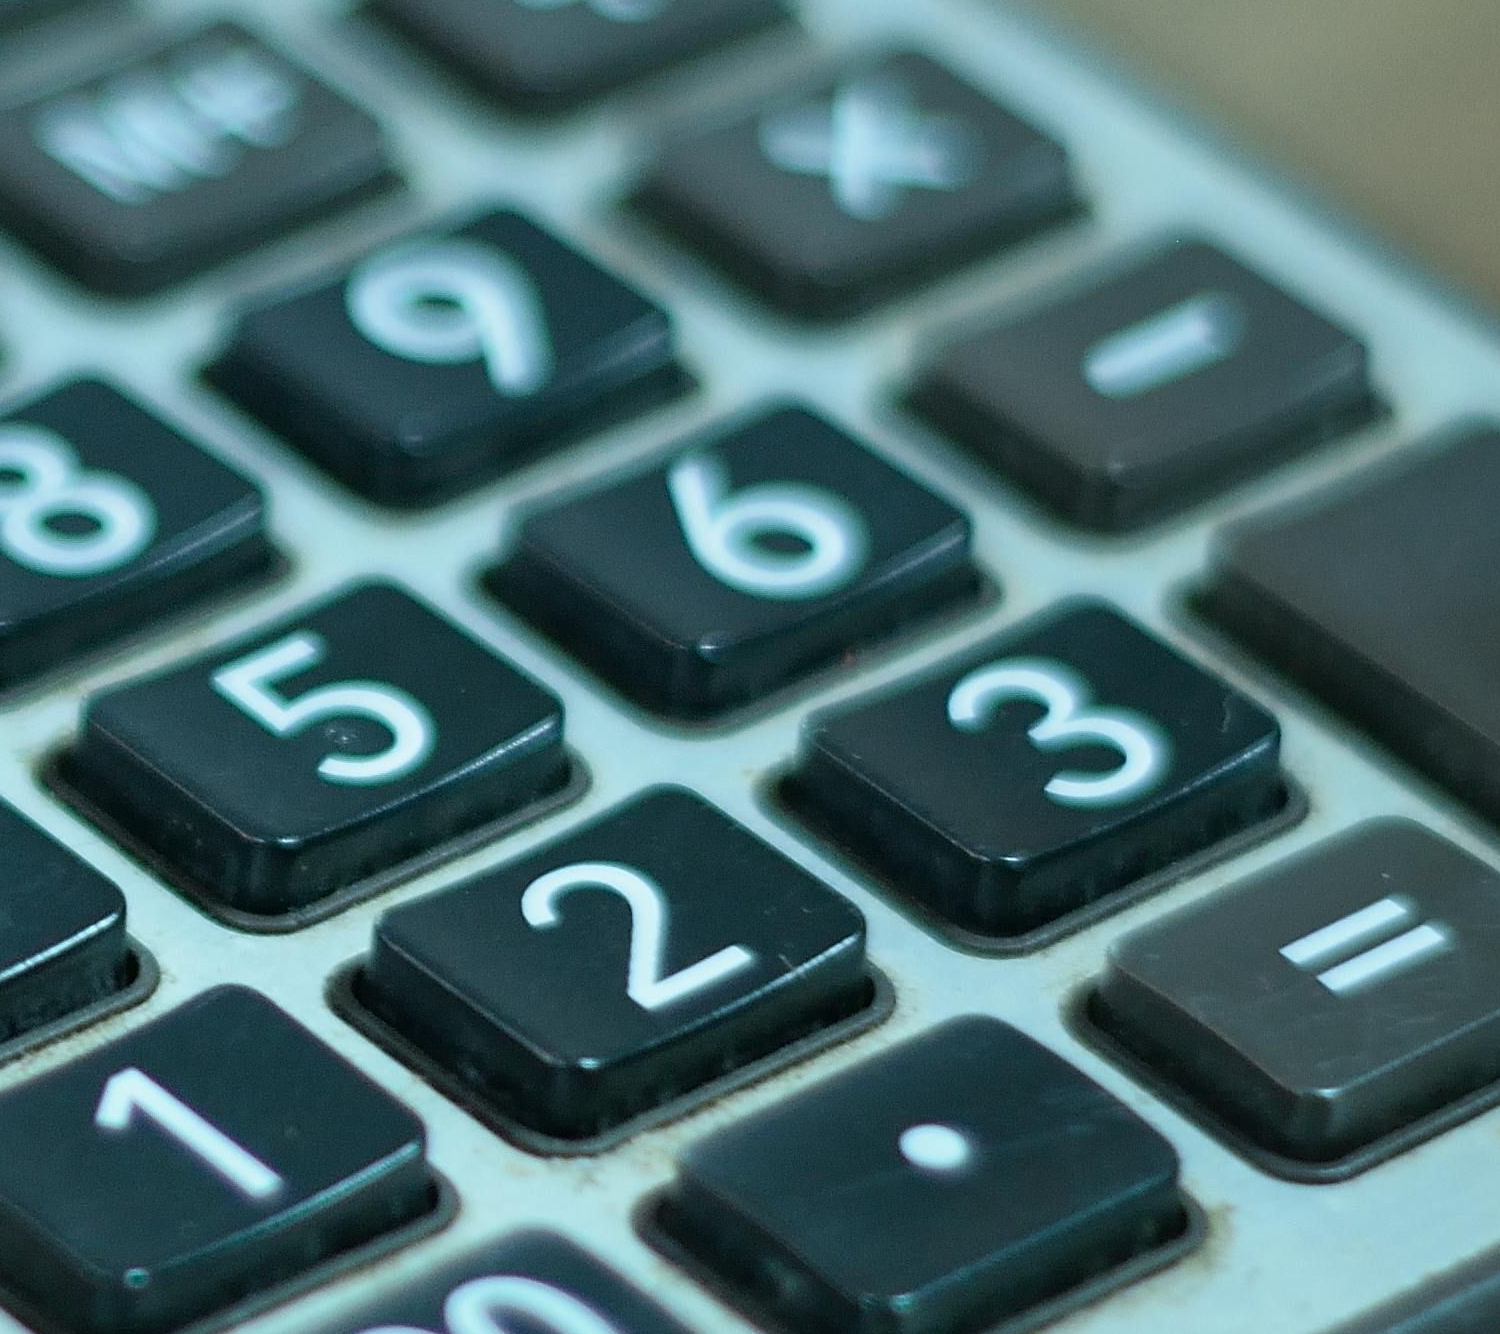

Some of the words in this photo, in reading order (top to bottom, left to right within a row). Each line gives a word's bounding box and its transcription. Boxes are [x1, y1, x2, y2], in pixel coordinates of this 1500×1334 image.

[345, 237, 555, 399] 9
[665, 452, 872, 602] 6
[208, 633, 438, 787] 5
[945, 657, 1178, 809] 3
[518, 857, 755, 1012] 2
[92, 1065, 286, 1202] 1
